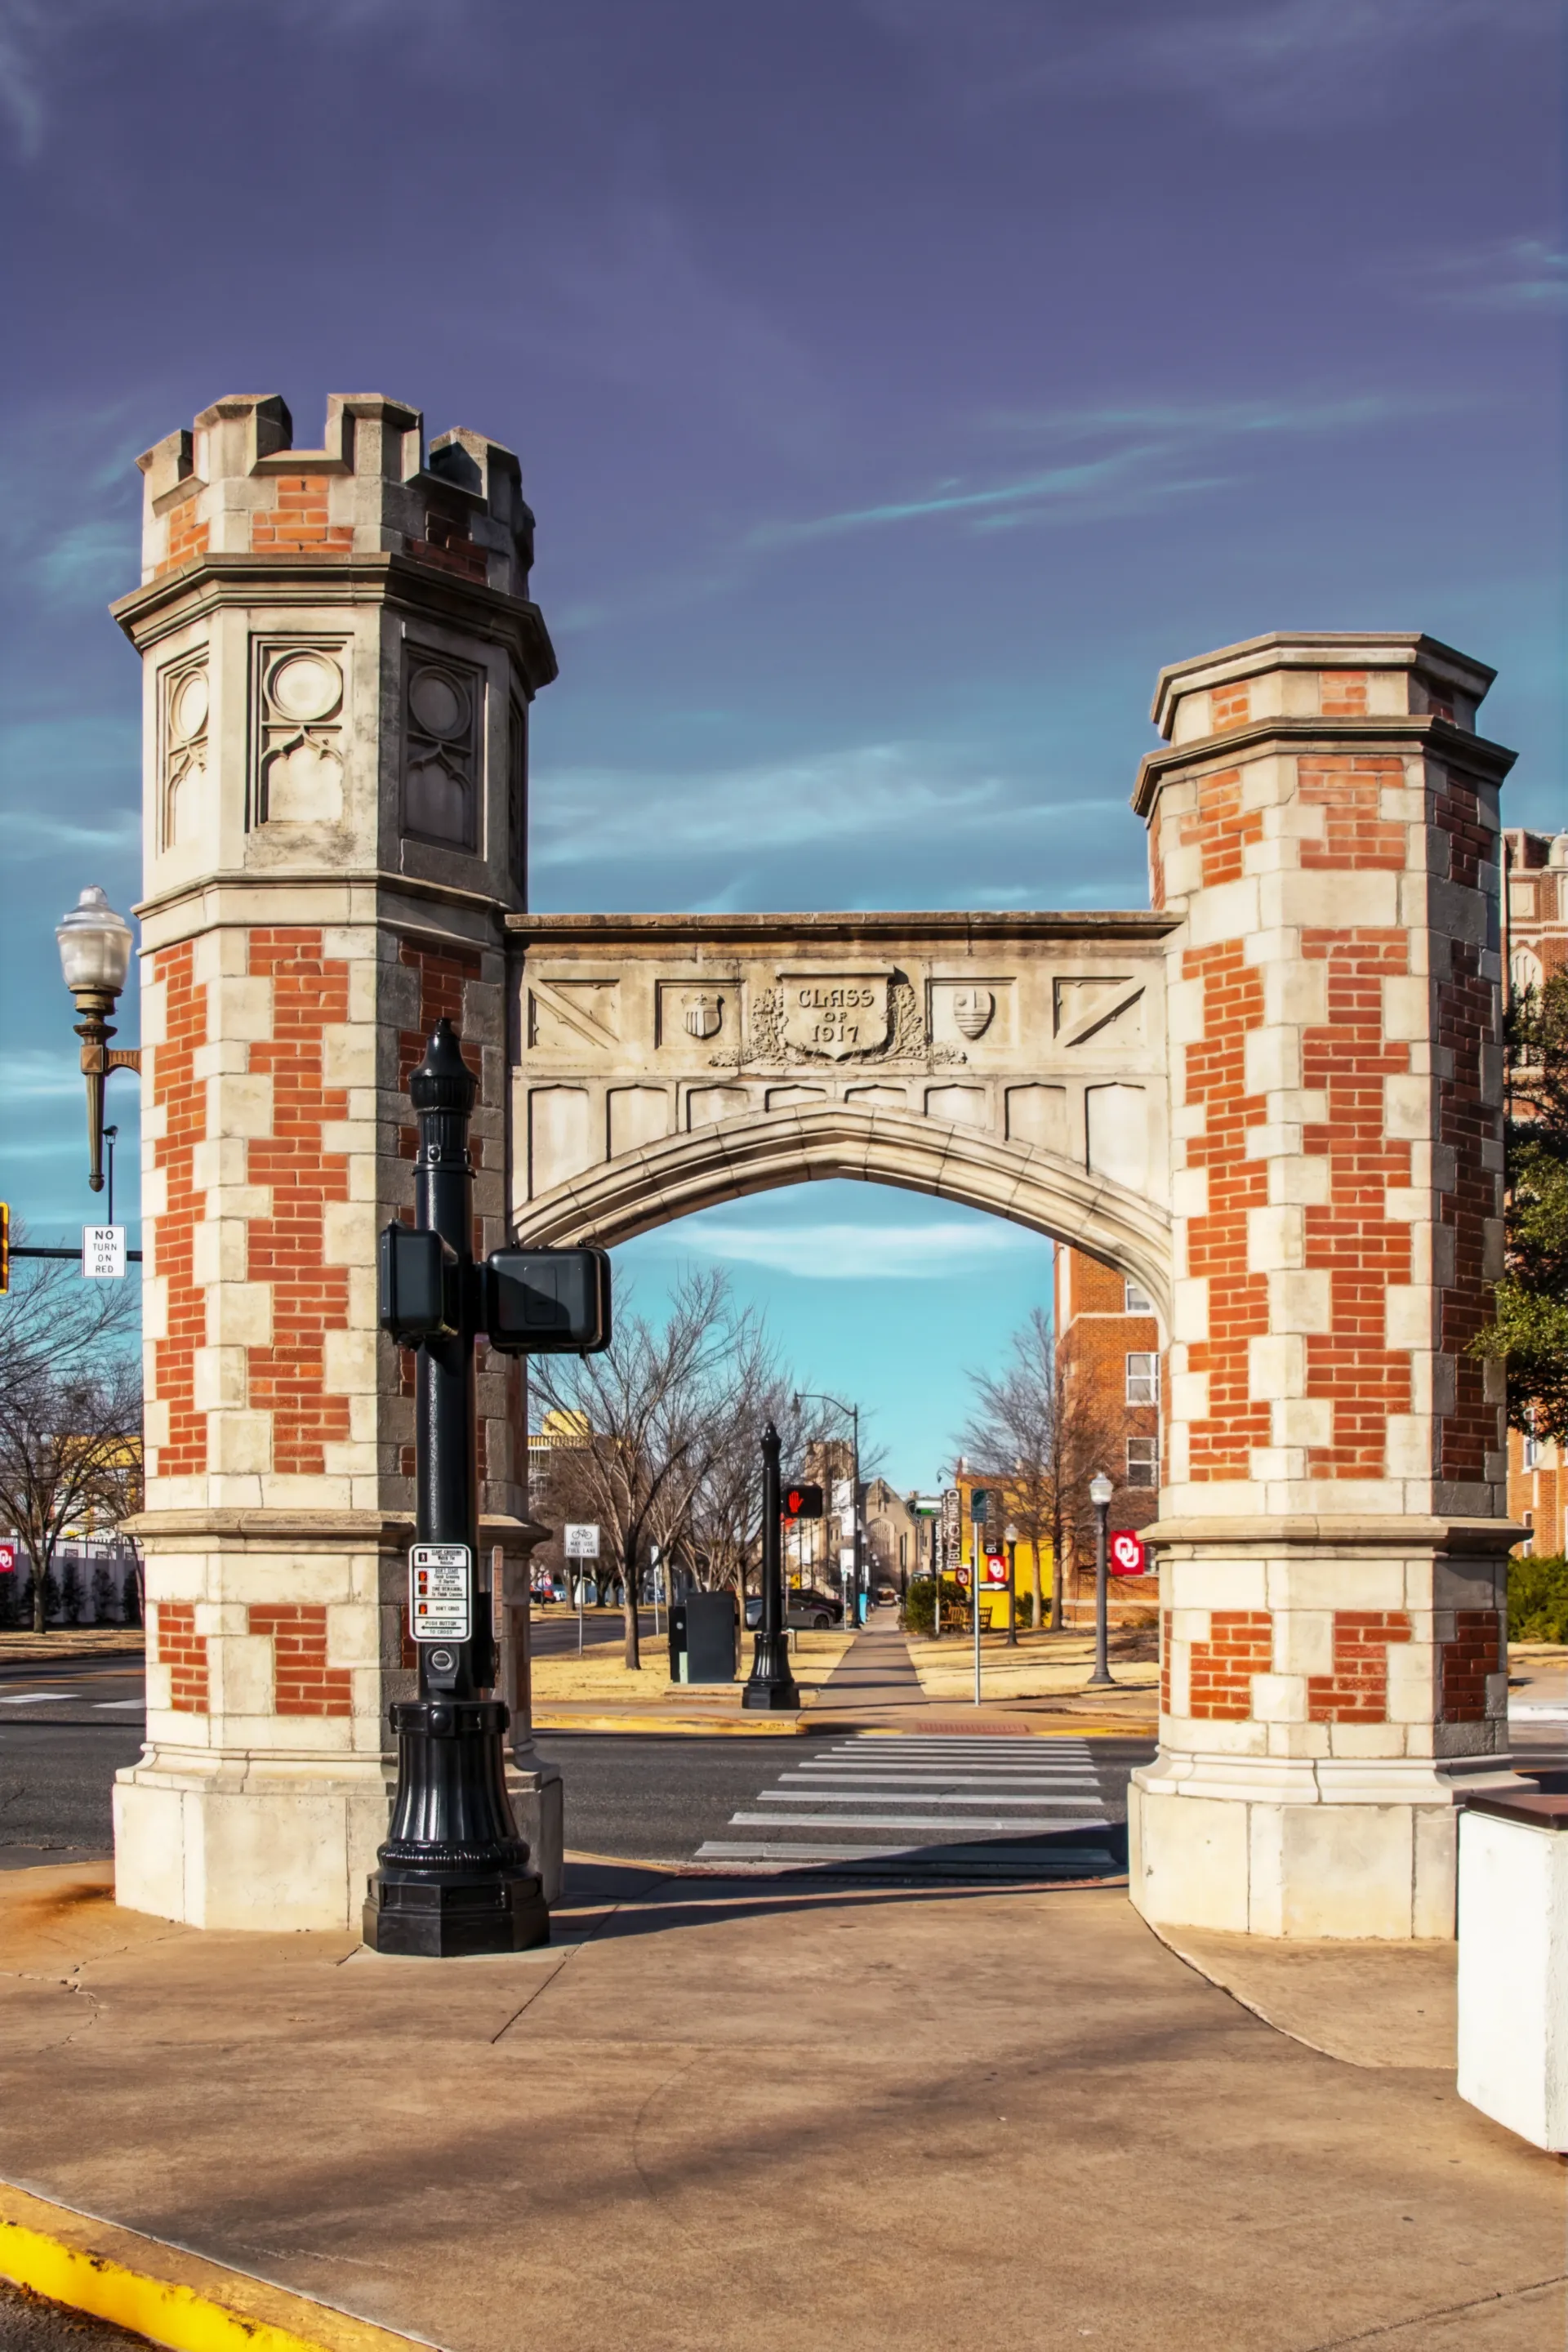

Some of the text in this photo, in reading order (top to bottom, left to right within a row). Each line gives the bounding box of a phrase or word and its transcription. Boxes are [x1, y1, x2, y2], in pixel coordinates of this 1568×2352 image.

[798, 989, 875, 1008] CLASS
[823, 1012, 848, 1023] OF
[812, 1025, 859, 1043] 1917
[95, 1230, 114, 1240] NO
[93, 1243, 118, 1251] TURN
[1114, 1536, 1139, 1568] OU
